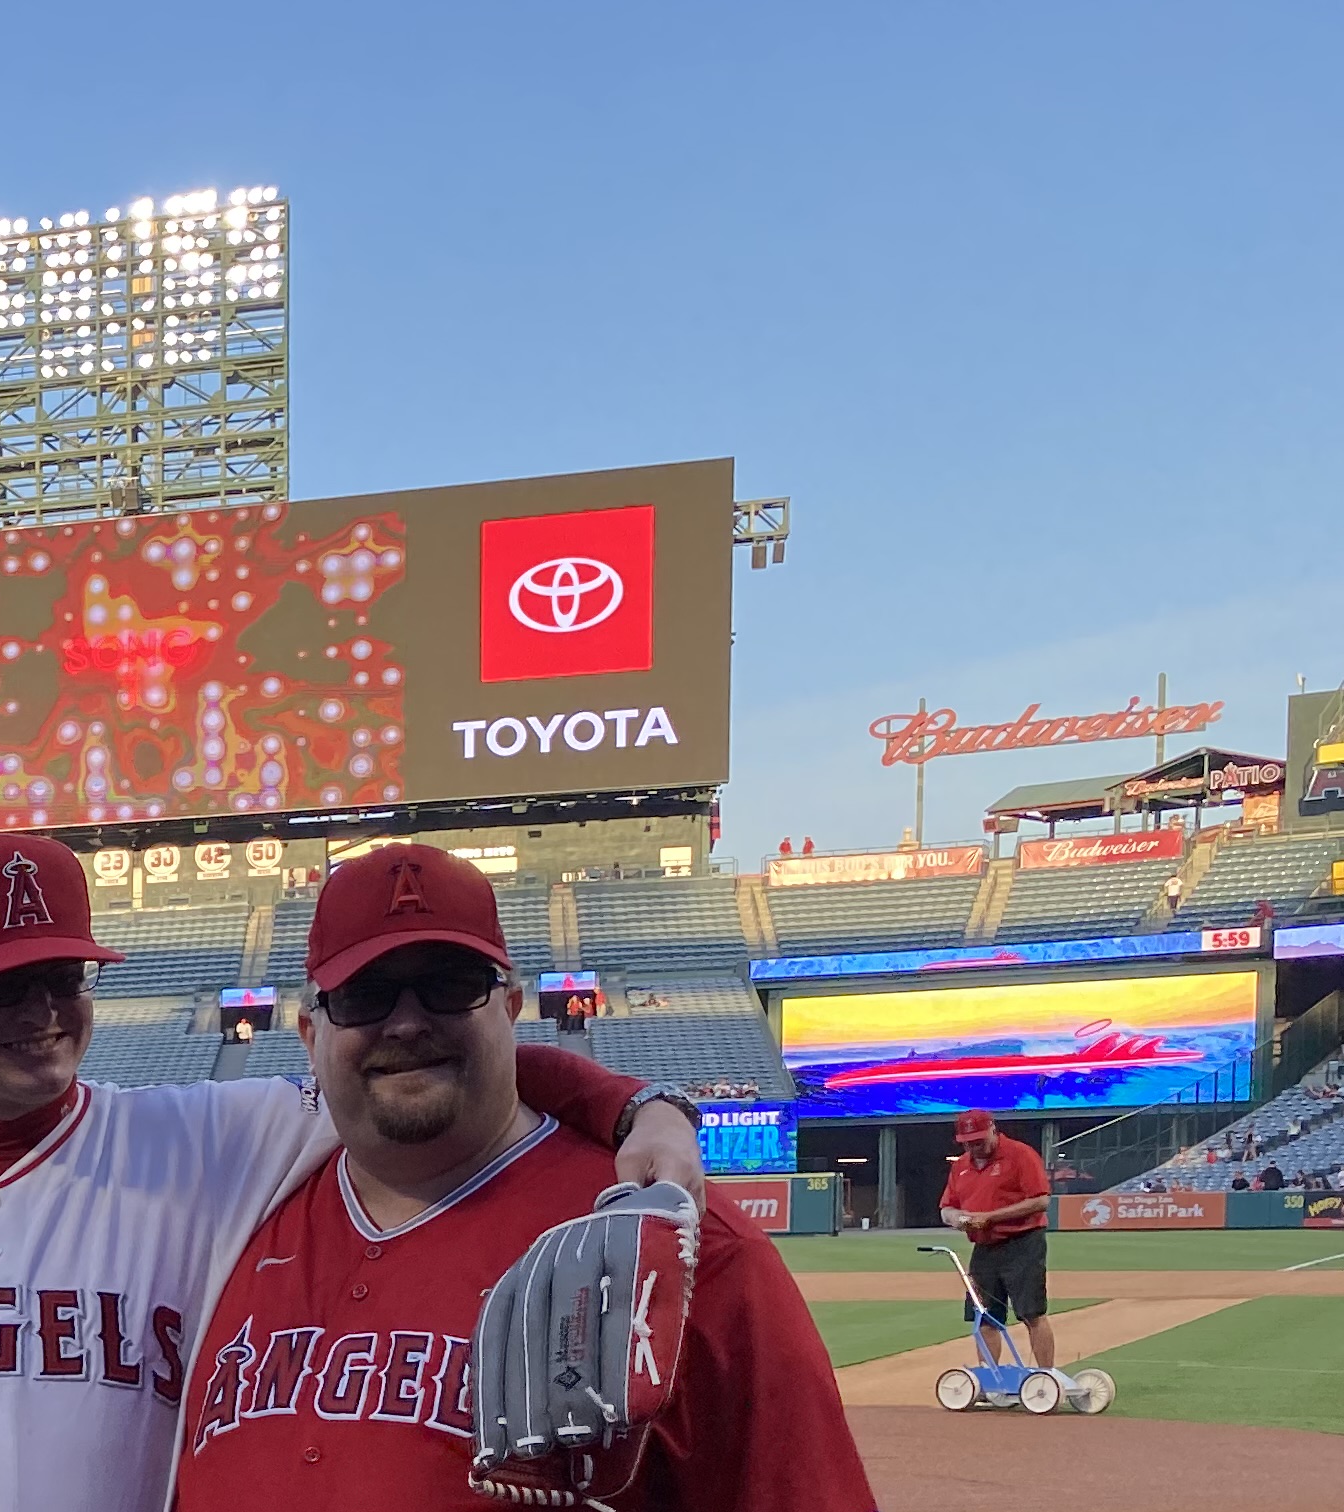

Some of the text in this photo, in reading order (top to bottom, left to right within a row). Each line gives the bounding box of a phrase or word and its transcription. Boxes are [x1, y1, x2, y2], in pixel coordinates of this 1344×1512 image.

[452, 706, 679, 758] TOYOTA
[870, 696, 1225, 767] Budweiser
[1210, 762, 1281, 789] PATIO
[252, 842, 276, 861] 50
[1043, 838, 1159, 862] Budweiser
[1212, 931, 1251, 949] 5:59
[806, 1178, 829, 1190] 365
[1117, 1203, 1204, 1218] Safari Park
[1284, 1195, 1304, 1208] 350
